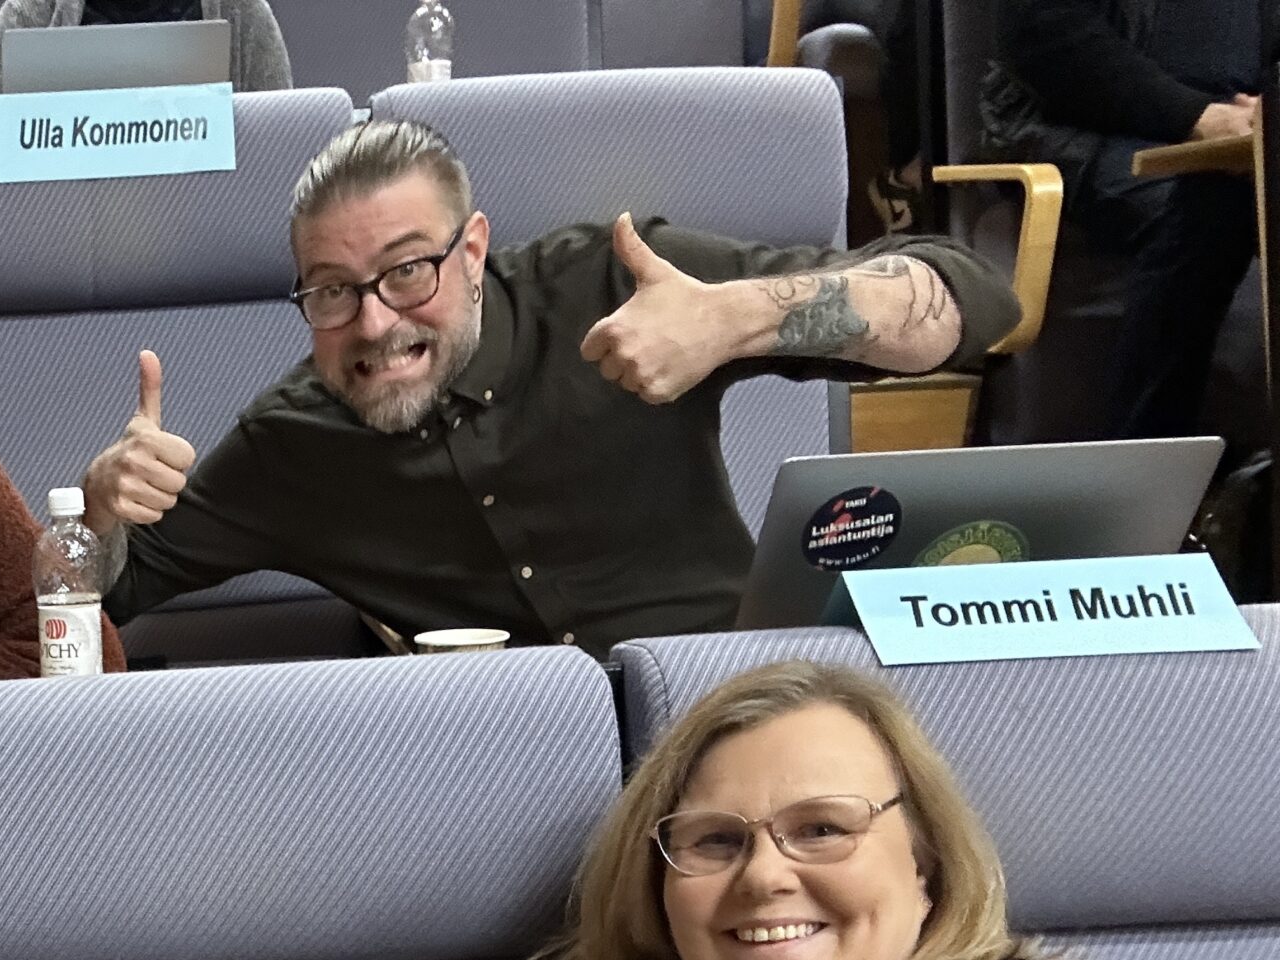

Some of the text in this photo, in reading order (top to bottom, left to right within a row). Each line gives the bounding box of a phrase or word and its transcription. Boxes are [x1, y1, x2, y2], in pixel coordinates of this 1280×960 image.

[20, 116, 208, 149] Ulla Kommonen
[807, 525, 894, 549] asiantuntija
[812, 513, 894, 536] Luksusalan
[900, 582, 1196, 628] Tommi Muhli
